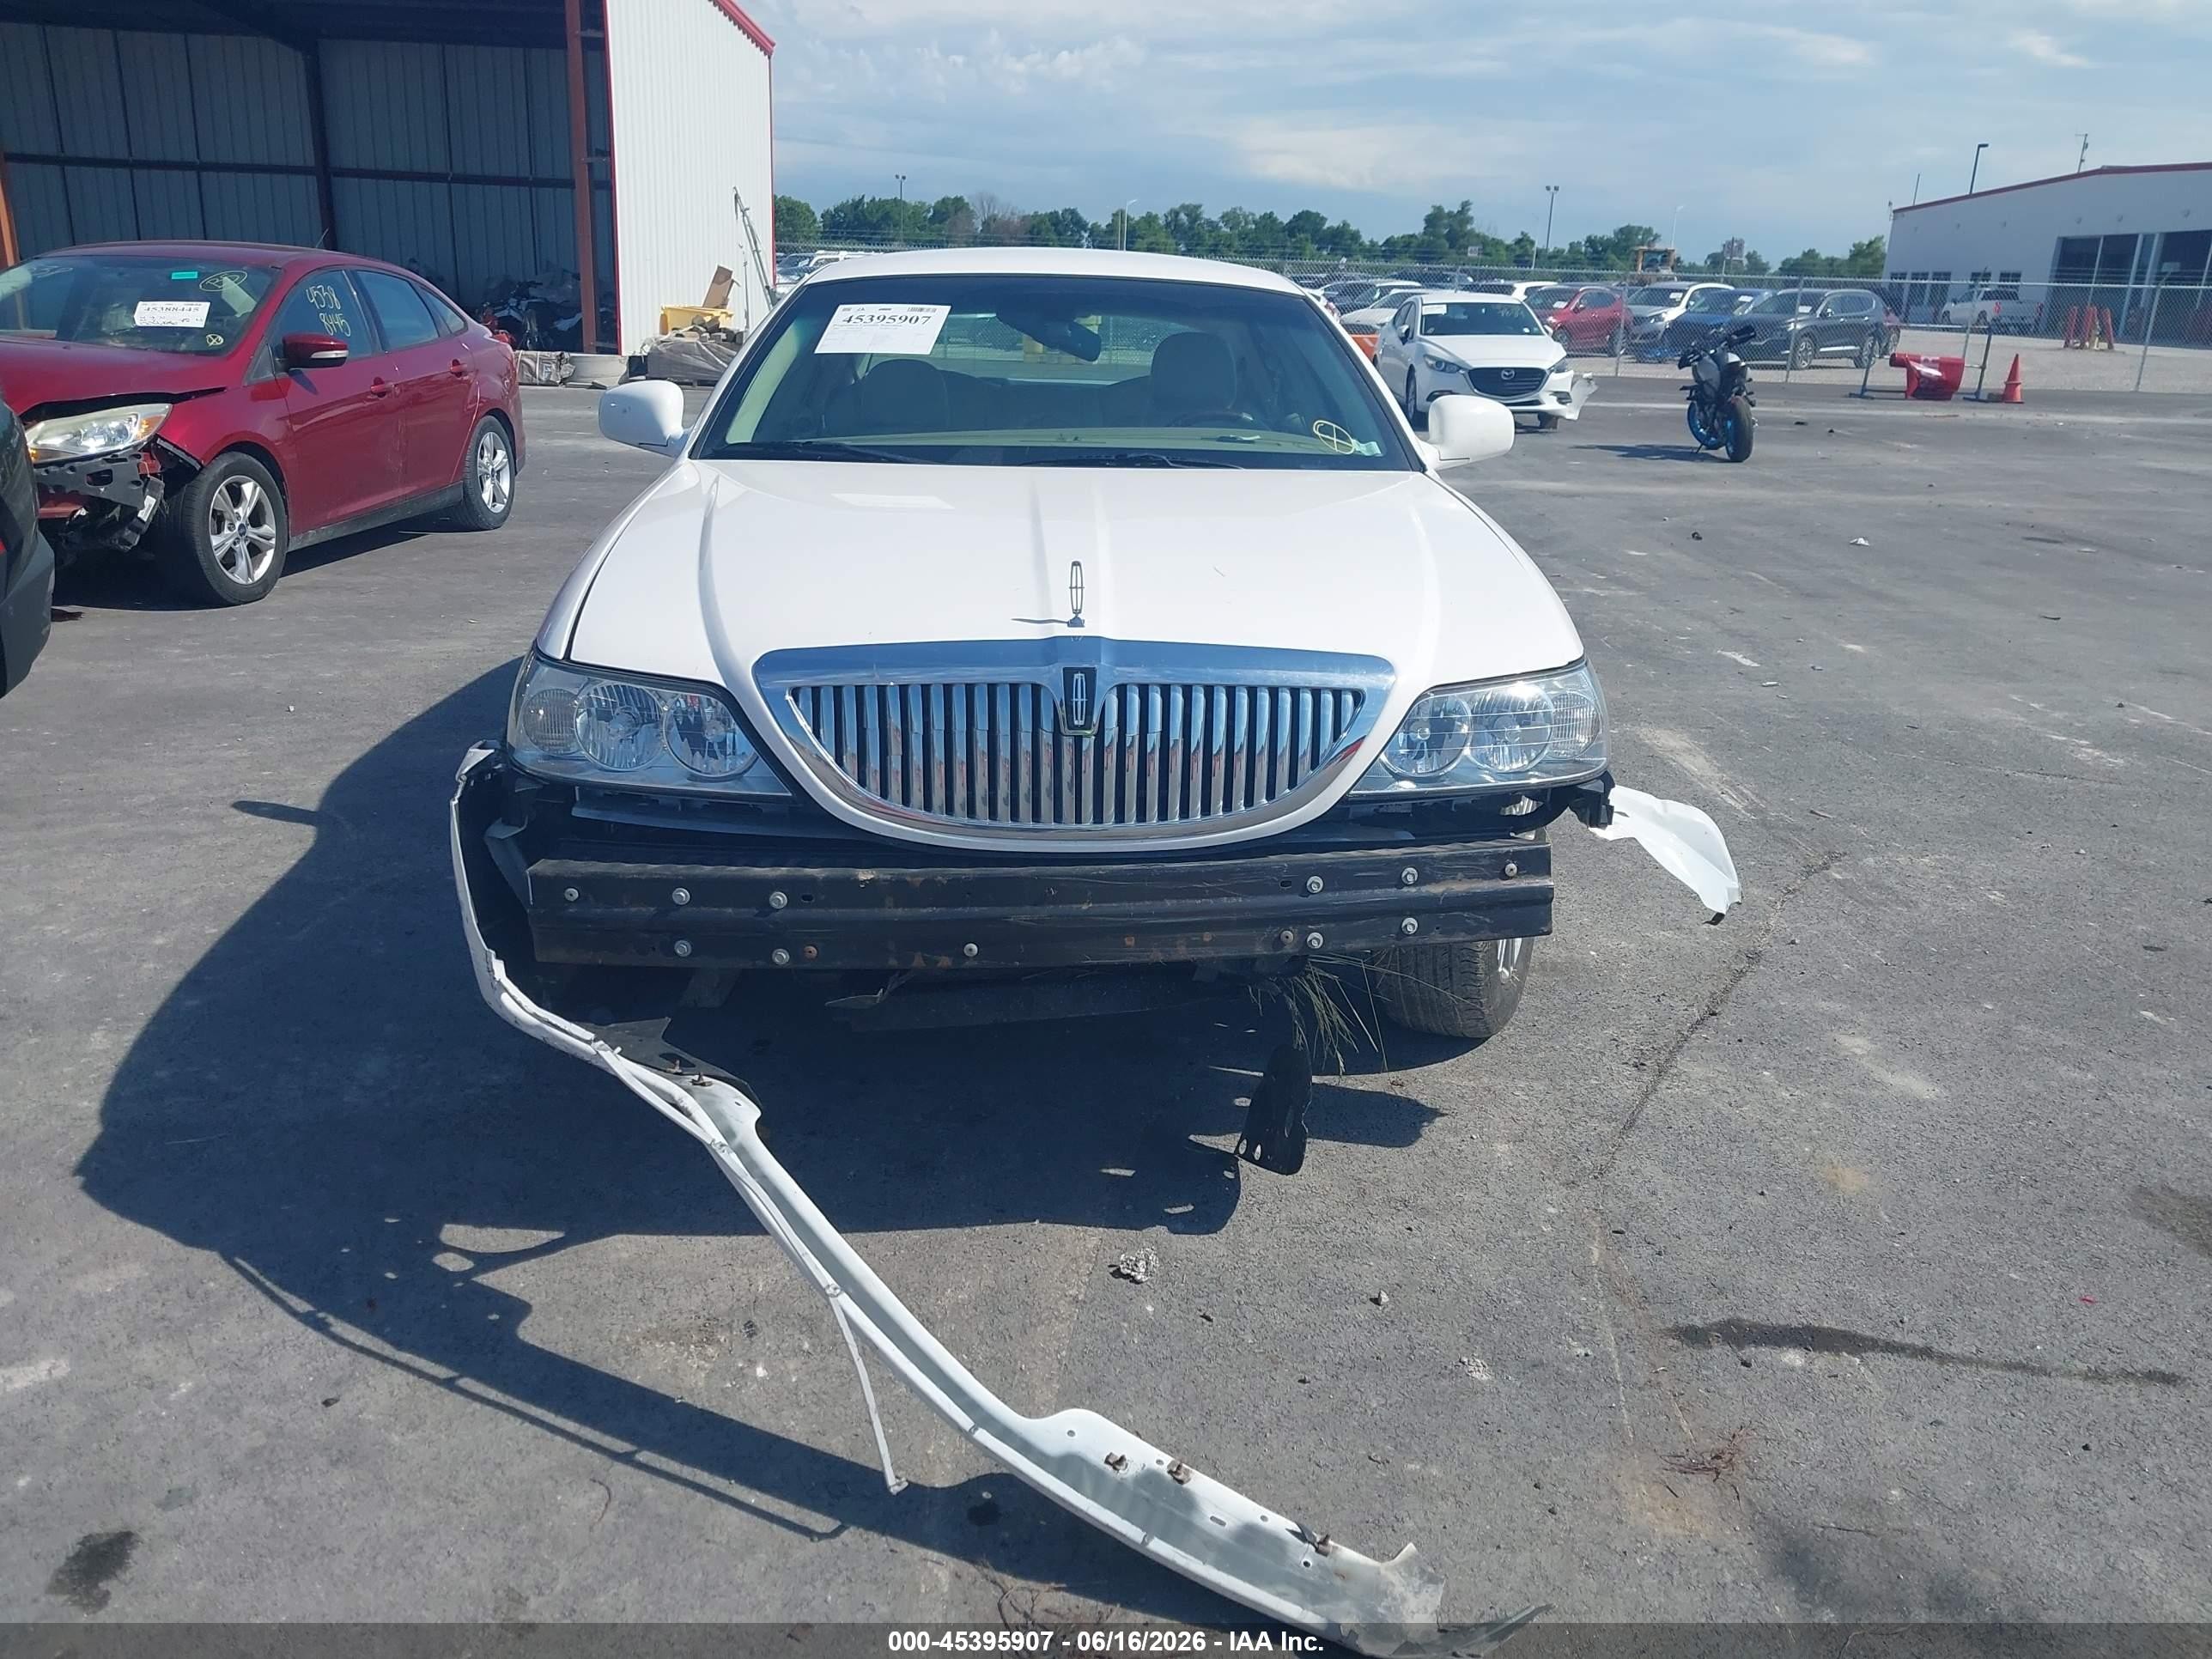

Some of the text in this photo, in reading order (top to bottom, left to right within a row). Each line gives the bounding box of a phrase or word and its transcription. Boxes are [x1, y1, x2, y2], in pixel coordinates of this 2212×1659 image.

[305, 284, 341, 310] 4538
[319, 313, 351, 337] 8445
[842, 314, 932, 325] 45395907
